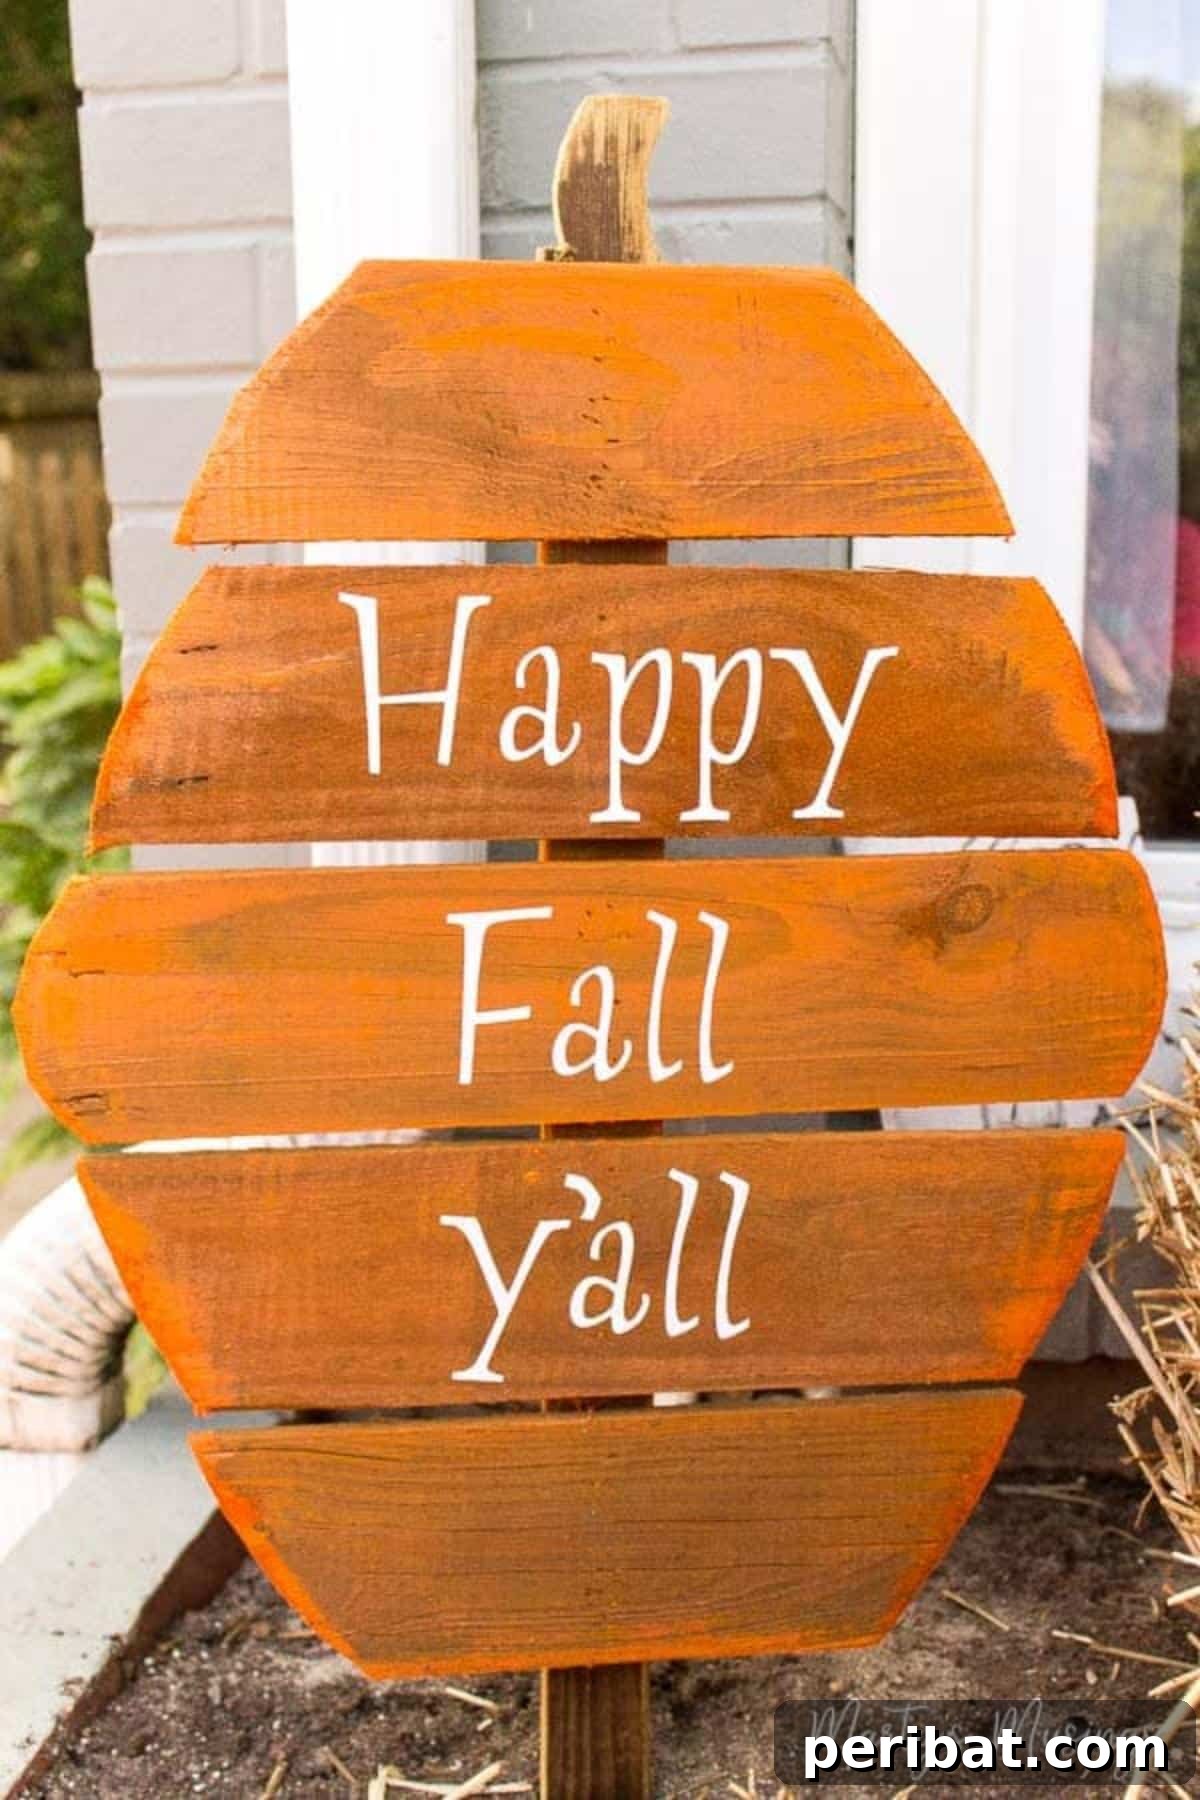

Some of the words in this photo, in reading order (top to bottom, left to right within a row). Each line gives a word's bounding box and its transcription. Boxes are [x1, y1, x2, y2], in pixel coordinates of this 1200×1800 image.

[338, 591, 898, 823] Happy
[446, 906, 733, 1085] Fall
[440, 1168, 750, 1383] y'all
